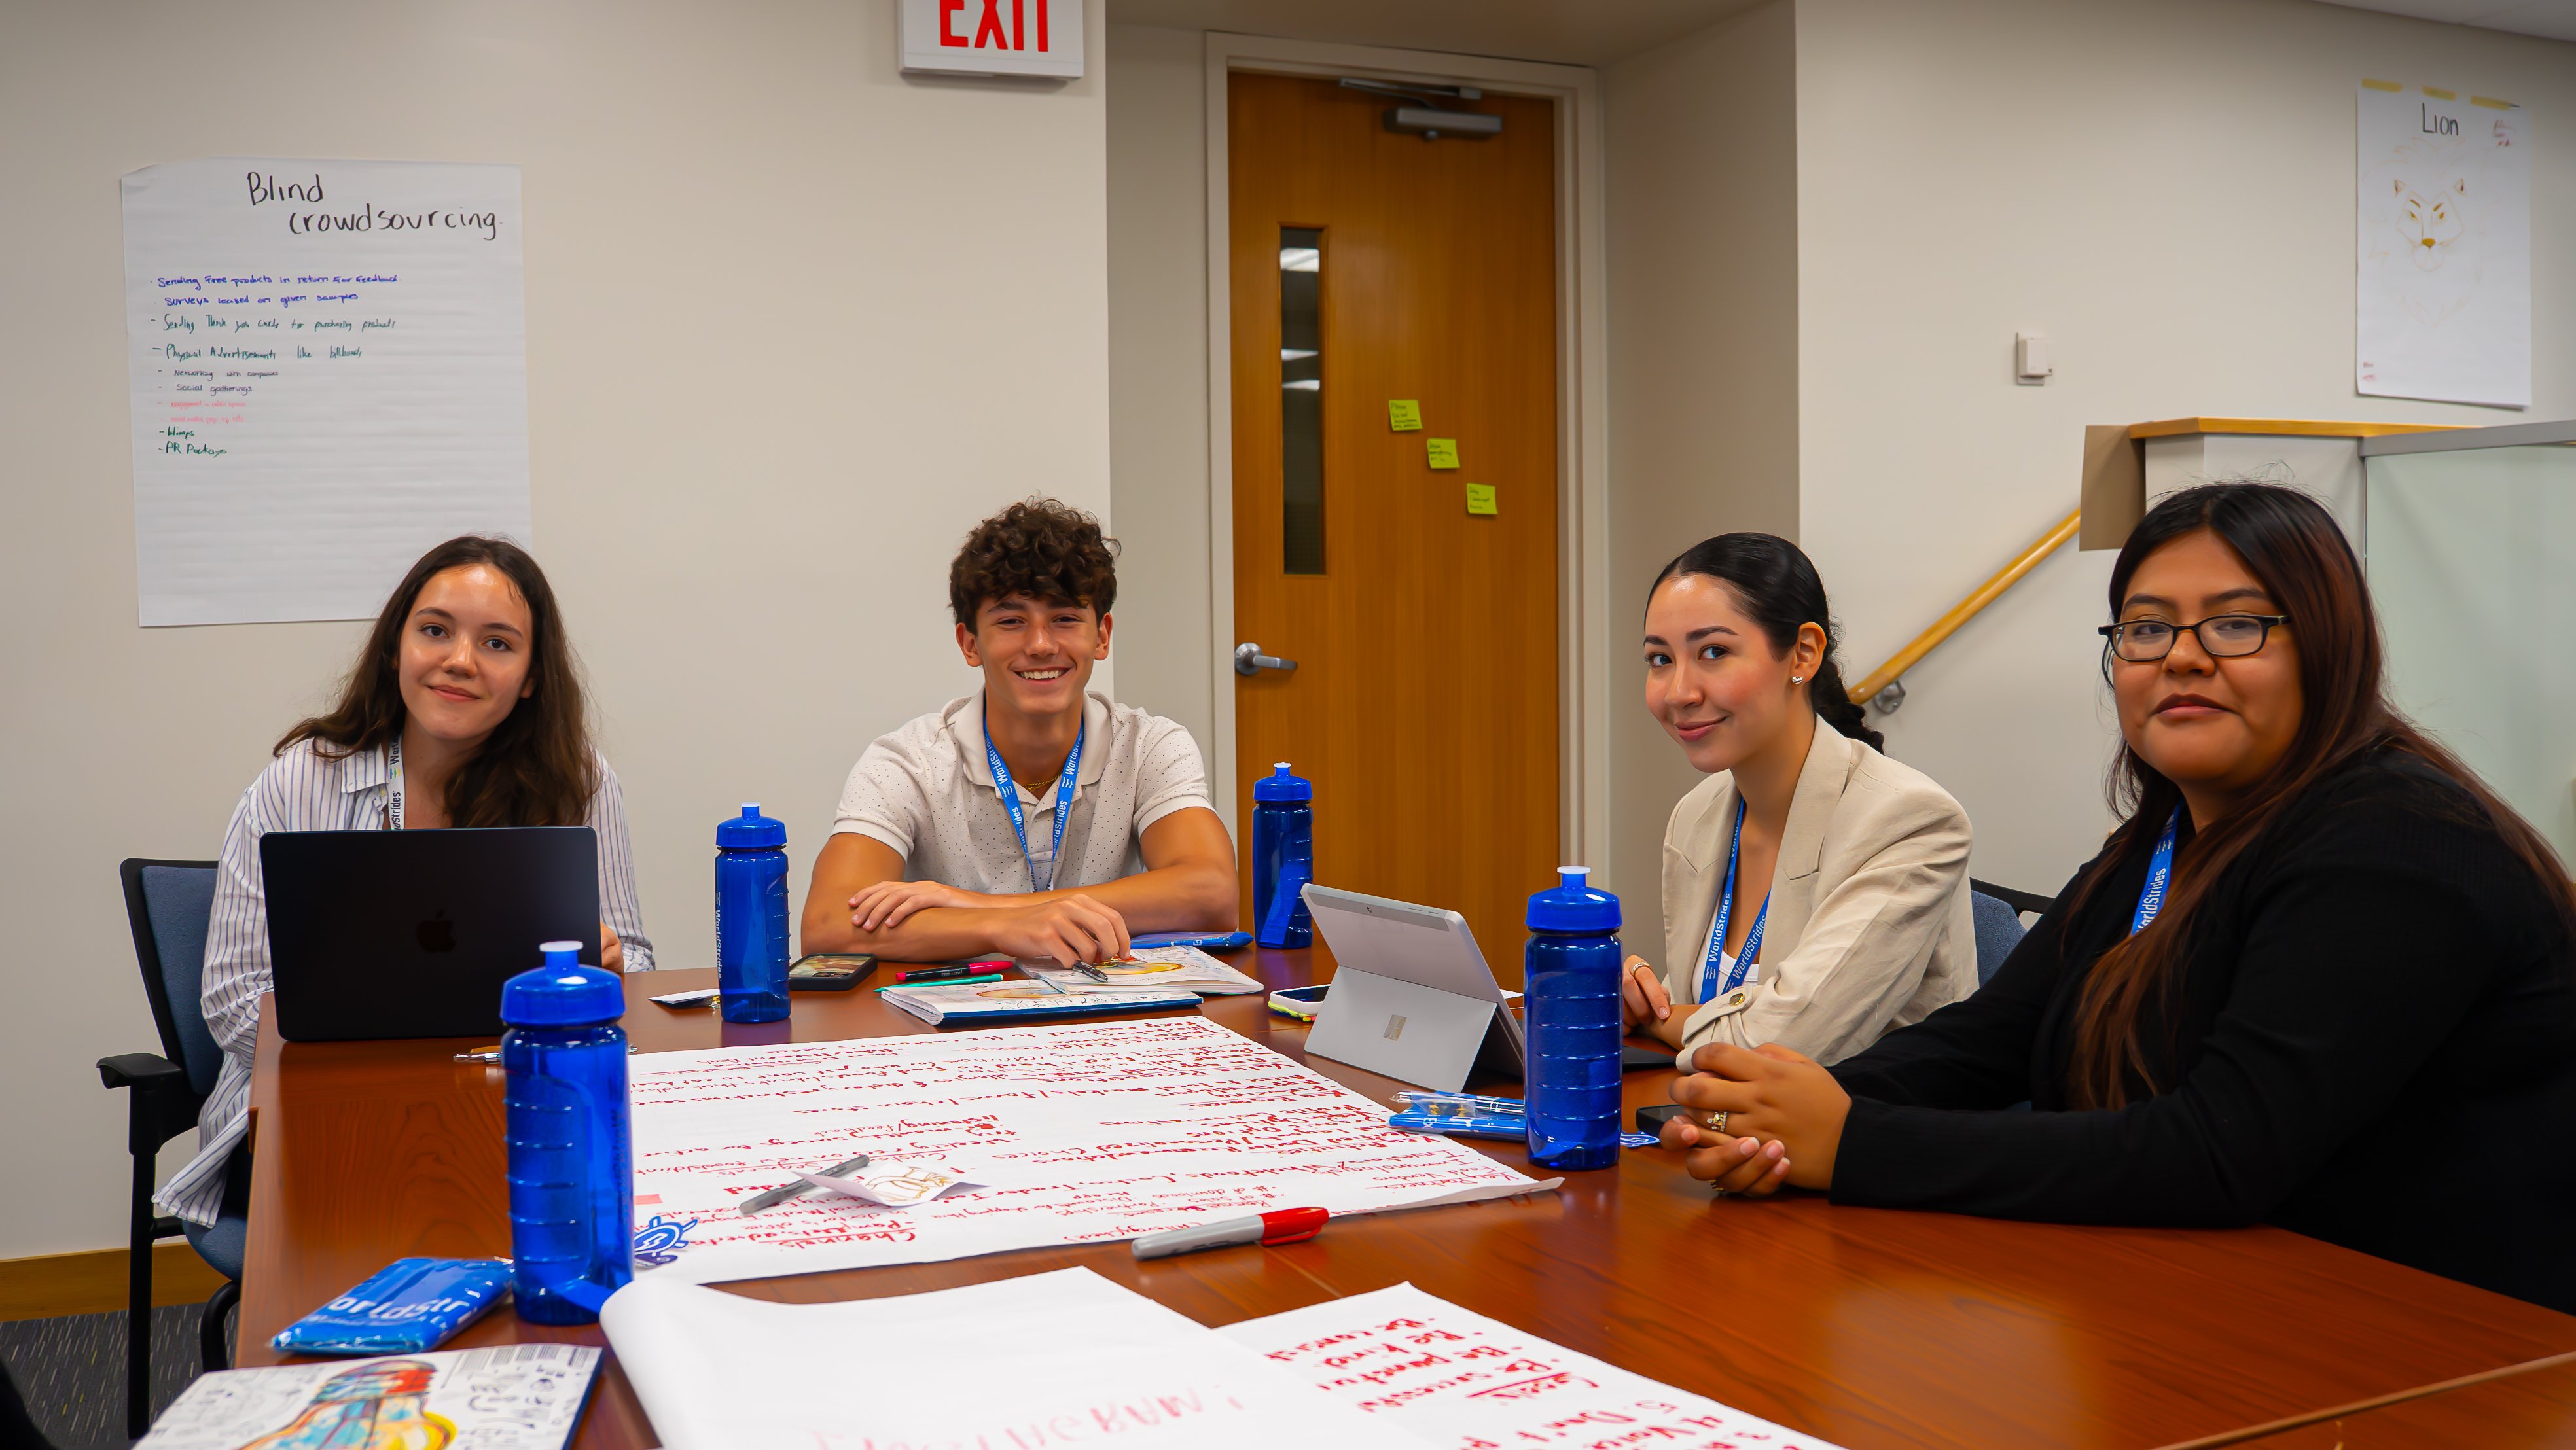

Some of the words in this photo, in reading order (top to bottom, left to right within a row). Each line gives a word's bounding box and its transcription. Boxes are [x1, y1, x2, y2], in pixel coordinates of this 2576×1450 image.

[2422, 102, 2460, 136] Lion
[247, 171, 325, 205] Blind
[166, 440, 182, 455] PR
[1708, 893, 1731, 963] WorldStrides
[1732, 914, 1766, 981] WorldStrides
[1404, 1329, 1467, 1345] Be
[1452, 1345, 1510, 1360] Be
[1495, 1358, 1552, 1374] Be
